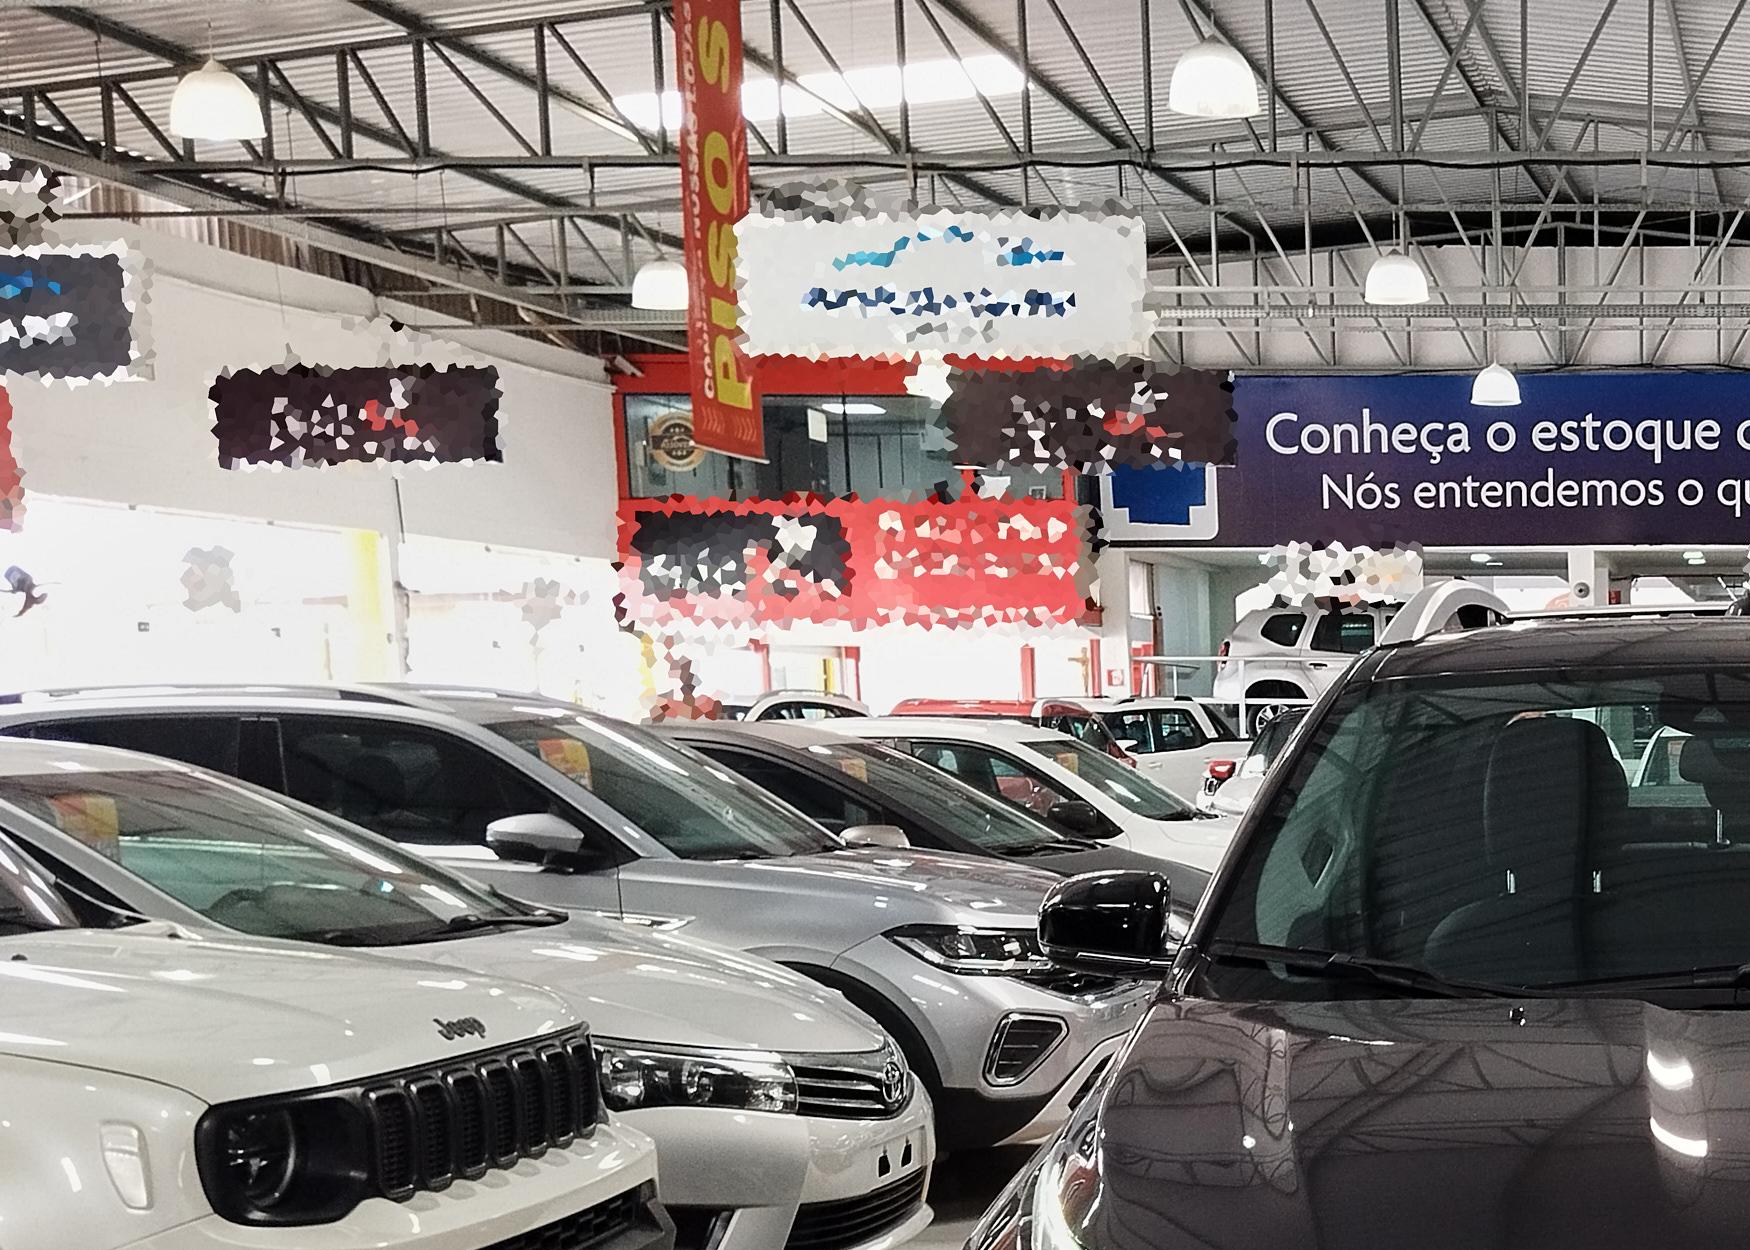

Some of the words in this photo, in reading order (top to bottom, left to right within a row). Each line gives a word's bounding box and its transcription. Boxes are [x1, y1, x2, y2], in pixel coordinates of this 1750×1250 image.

[1265, 408, 1471, 464] Conheça
[1486, 420, 1517, 452] o
[1531, 412, 1721, 464] estoque
[1321, 471, 1401, 510] Nós
[1413, 467, 1665, 509] entendemos
[1677, 478, 1704, 506] o
[433, 1017, 486, 1041] Jeep
